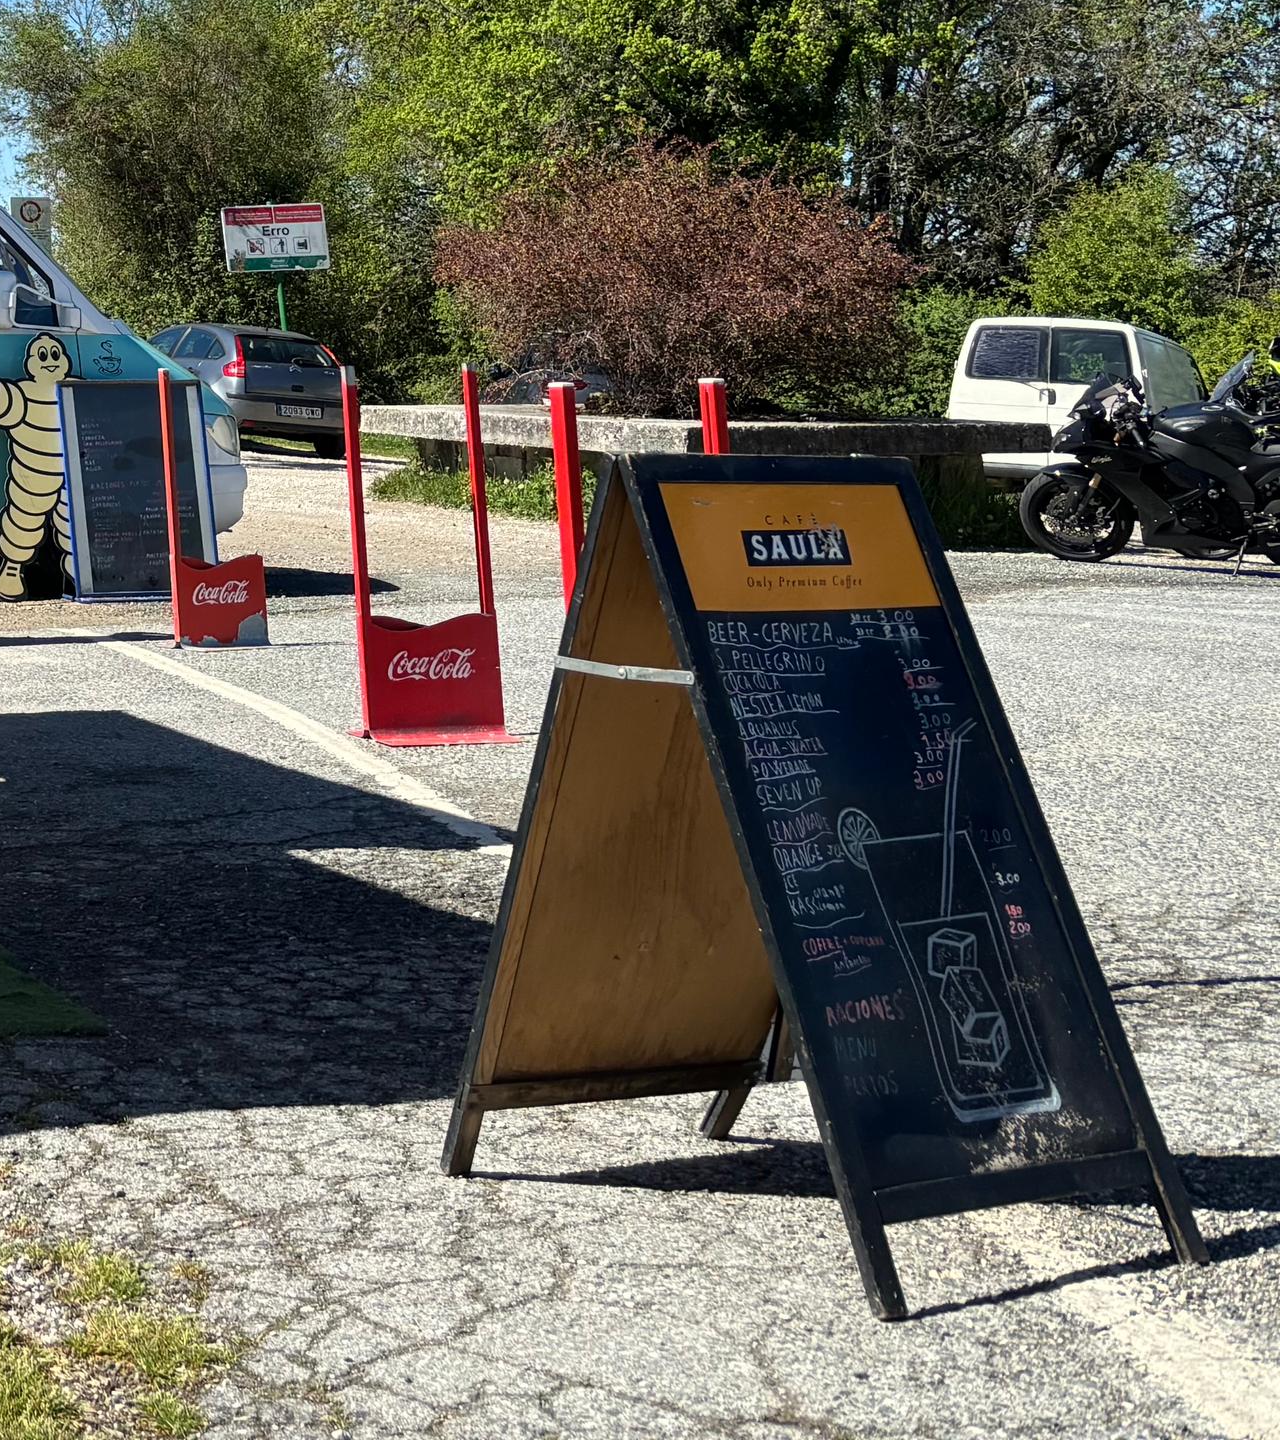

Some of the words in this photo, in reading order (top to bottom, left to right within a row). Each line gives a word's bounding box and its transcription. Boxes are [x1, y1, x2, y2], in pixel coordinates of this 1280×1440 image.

[262, 226, 290, 236] Erro
[751, 533, 844, 561] SAULA
[747, 576, 773, 591] Only
[778, 576, 827, 588] Premium
[832, 575, 863, 590] Coffee
[729, 694, 786, 718] NESTEA
[787, 692, 824, 712] LEMON
[739, 720, 800, 738] AQUARIUS
[751, 760, 811, 778] POWERADE
[756, 780, 802, 806] SEVEN
[805, 777, 823, 796] UP
[767, 812, 831, 842] LEMONADE
[773, 843, 824, 871] ORANGE
[802, 936, 843, 956] COFFEE
[825, 992, 905, 1028] RACIONES
